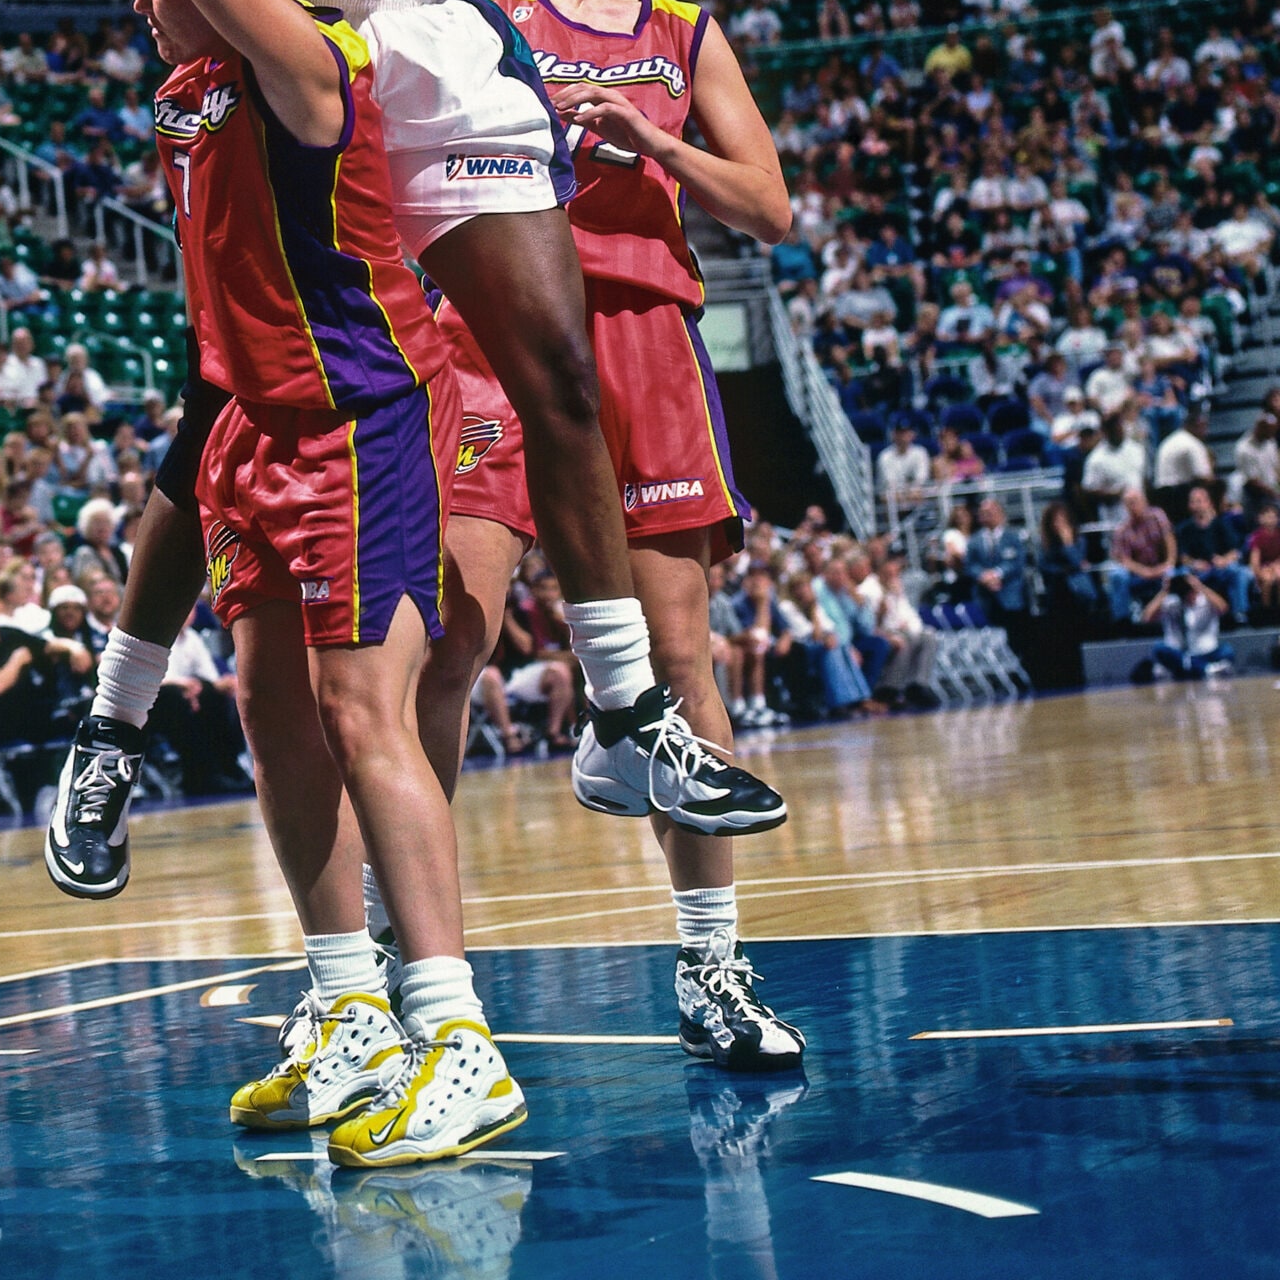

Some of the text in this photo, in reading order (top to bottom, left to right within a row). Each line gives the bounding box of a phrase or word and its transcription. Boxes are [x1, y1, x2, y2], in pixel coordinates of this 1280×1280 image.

[532, 50, 687, 95] Mercury
[466, 158, 534, 176] WNBA
[641, 480, 704, 503] WNBA
